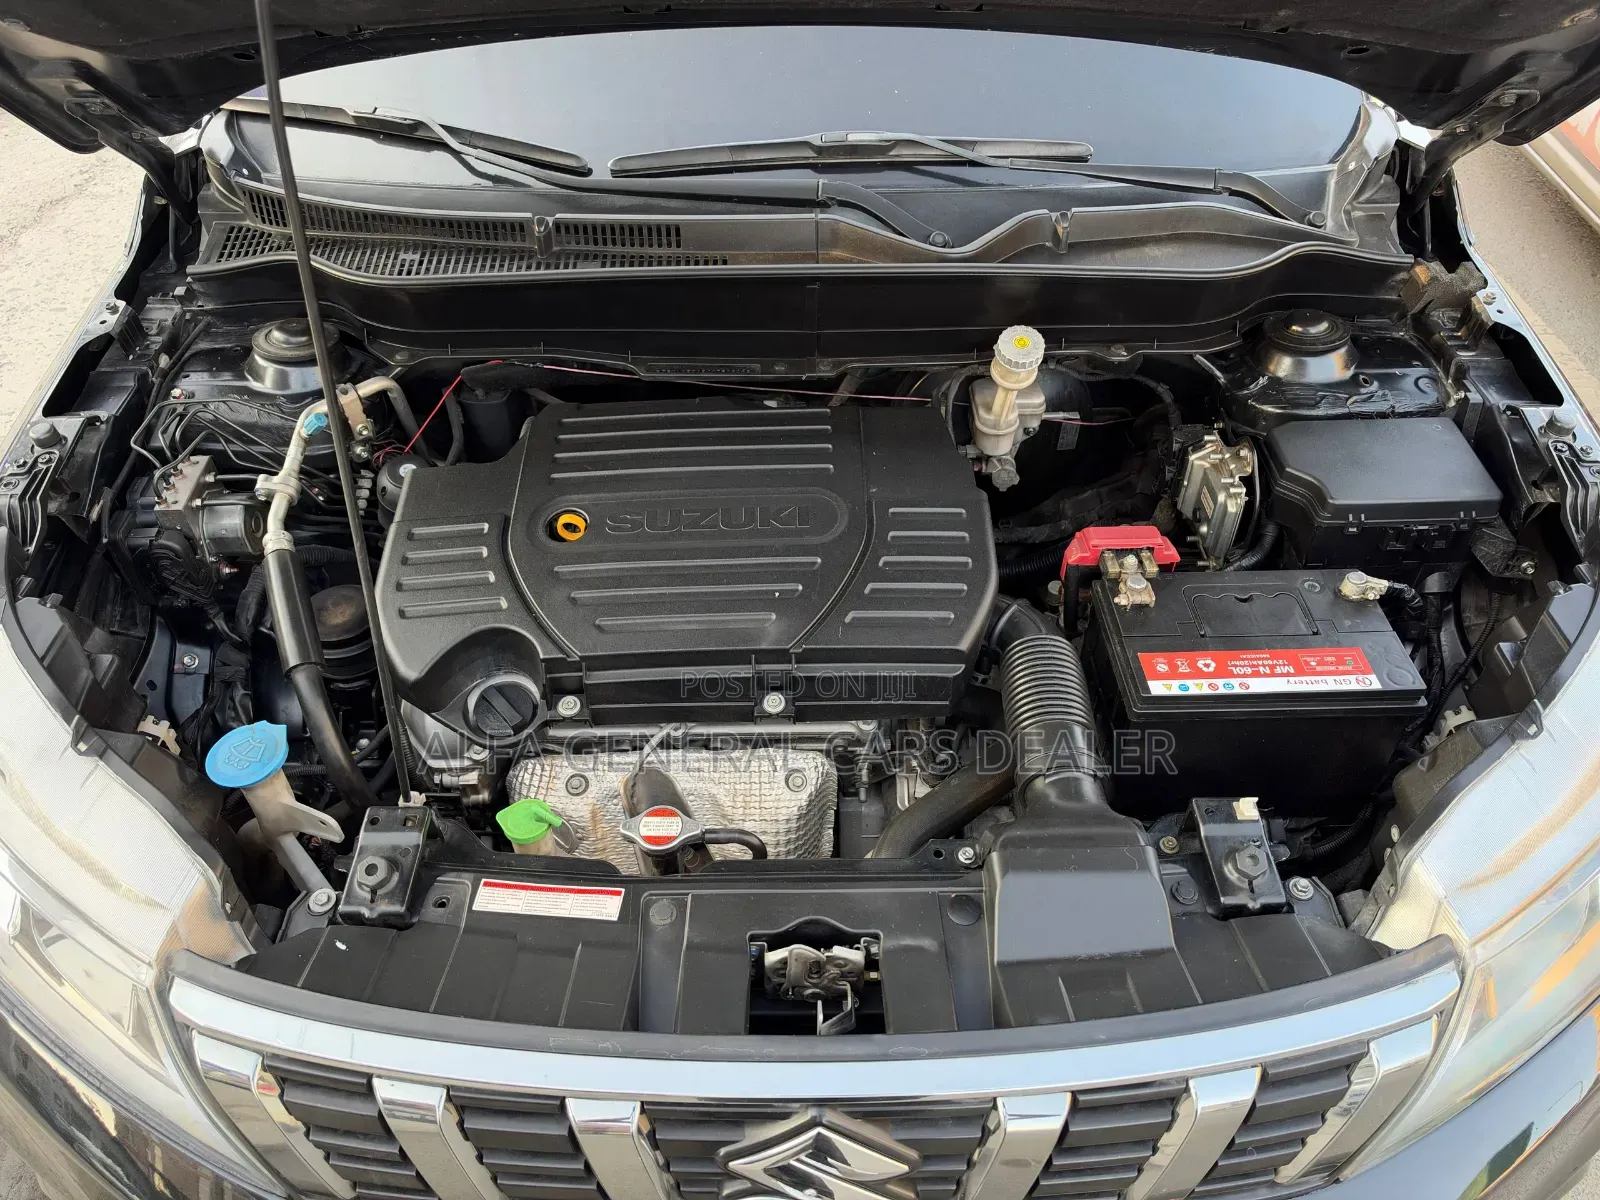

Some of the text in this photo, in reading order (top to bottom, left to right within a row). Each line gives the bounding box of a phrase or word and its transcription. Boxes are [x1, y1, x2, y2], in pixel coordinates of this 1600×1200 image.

[605, 505, 810, 534] SUZUKI
[1227, 665, 1295, 675] MF N-60L
[1286, 677, 1352, 686] GN battery
